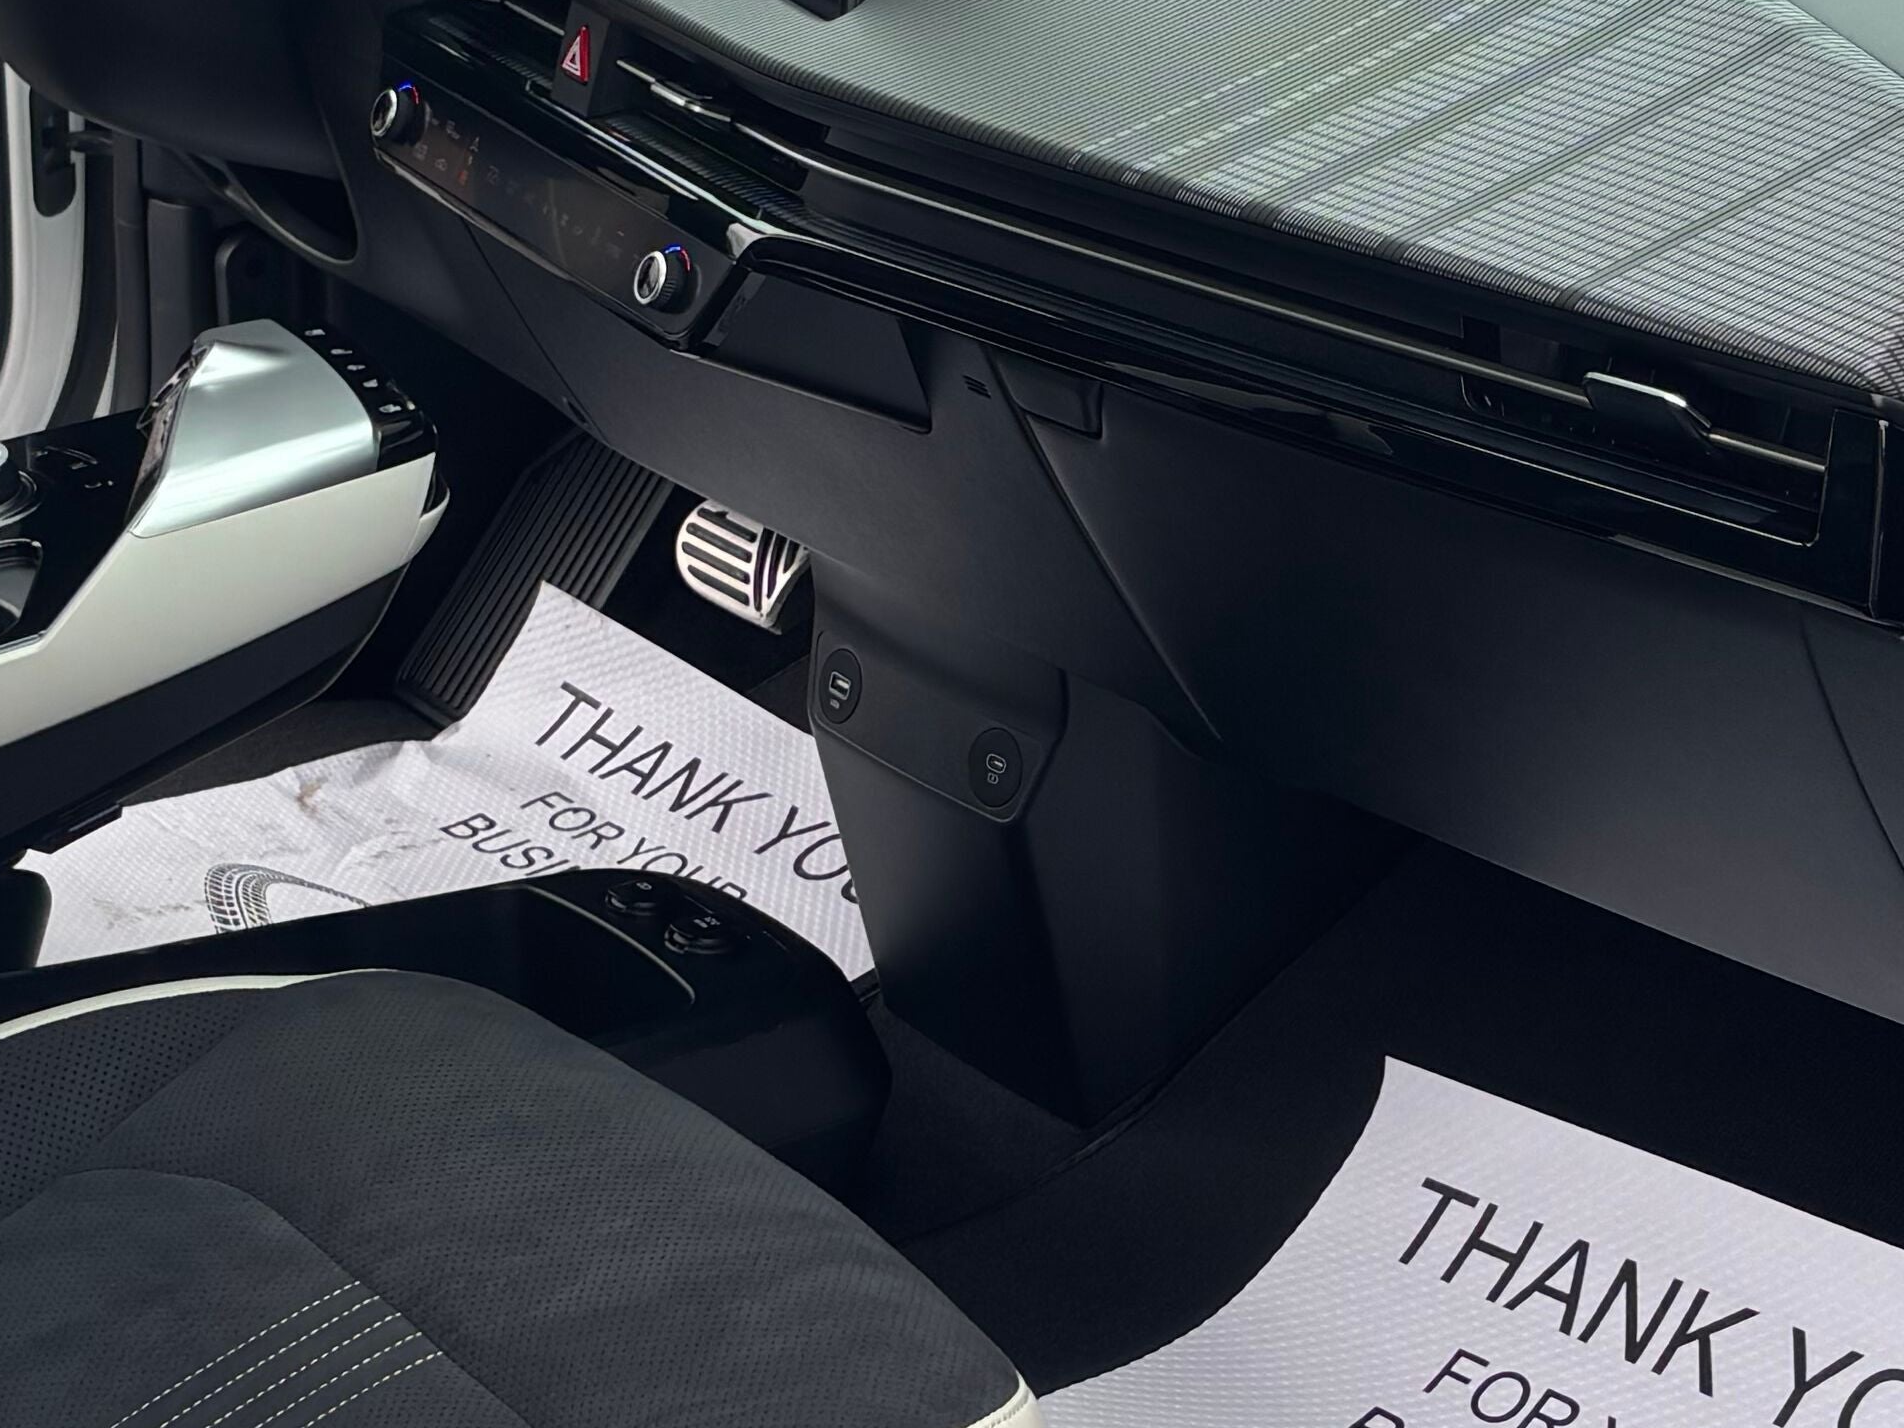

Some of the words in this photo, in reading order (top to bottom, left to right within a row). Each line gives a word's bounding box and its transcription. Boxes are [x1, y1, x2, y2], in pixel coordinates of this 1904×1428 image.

[520, 791, 626, 864] FOR
[534, 682, 772, 834] THANK
[1397, 1177, 1760, 1398] THANK
